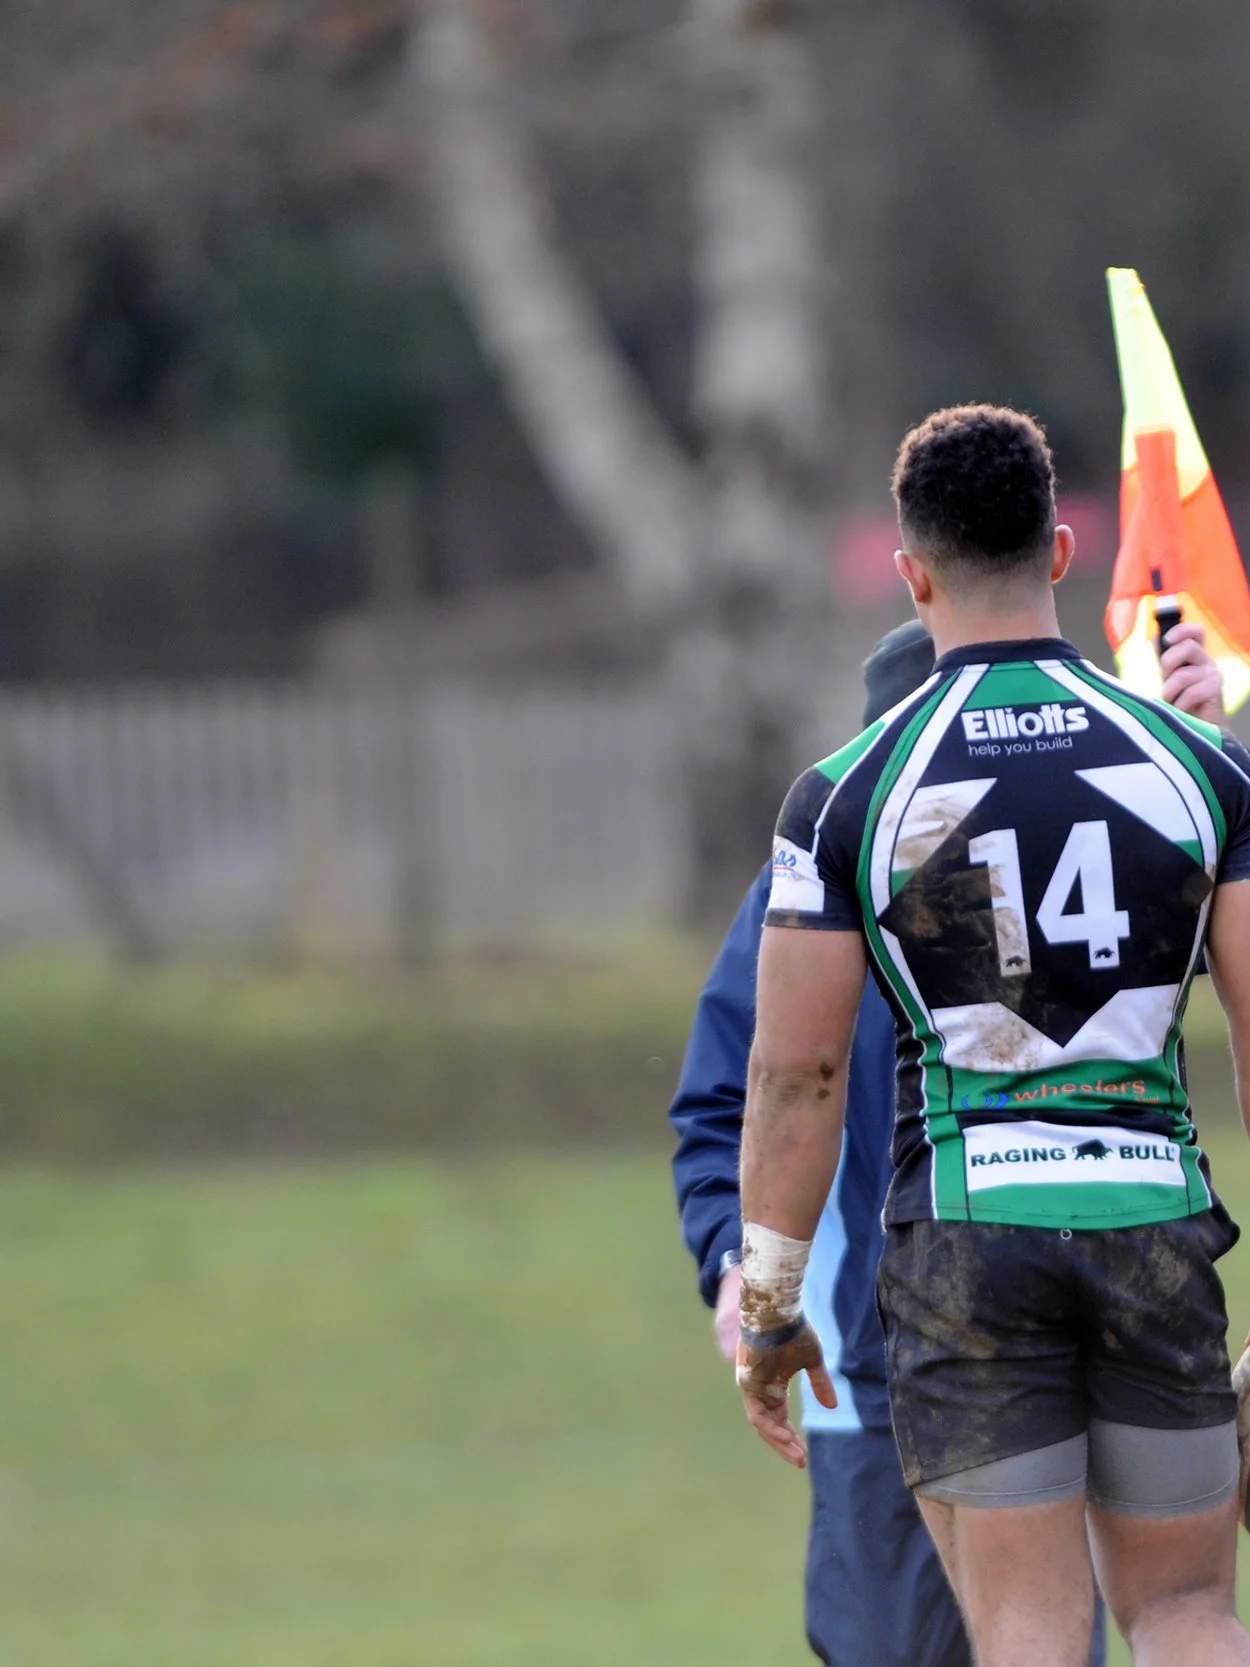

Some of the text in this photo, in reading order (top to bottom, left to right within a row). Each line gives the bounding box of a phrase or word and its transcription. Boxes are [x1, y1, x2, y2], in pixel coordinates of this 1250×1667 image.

[961, 703, 1090, 741] Elliotts
[968, 736, 1073, 757] help you build
[968, 819, 1131, 978] 14
[1014, 1080, 1146, 1102] wheelers
[971, 1145, 1174, 1167] RAGING BULL
